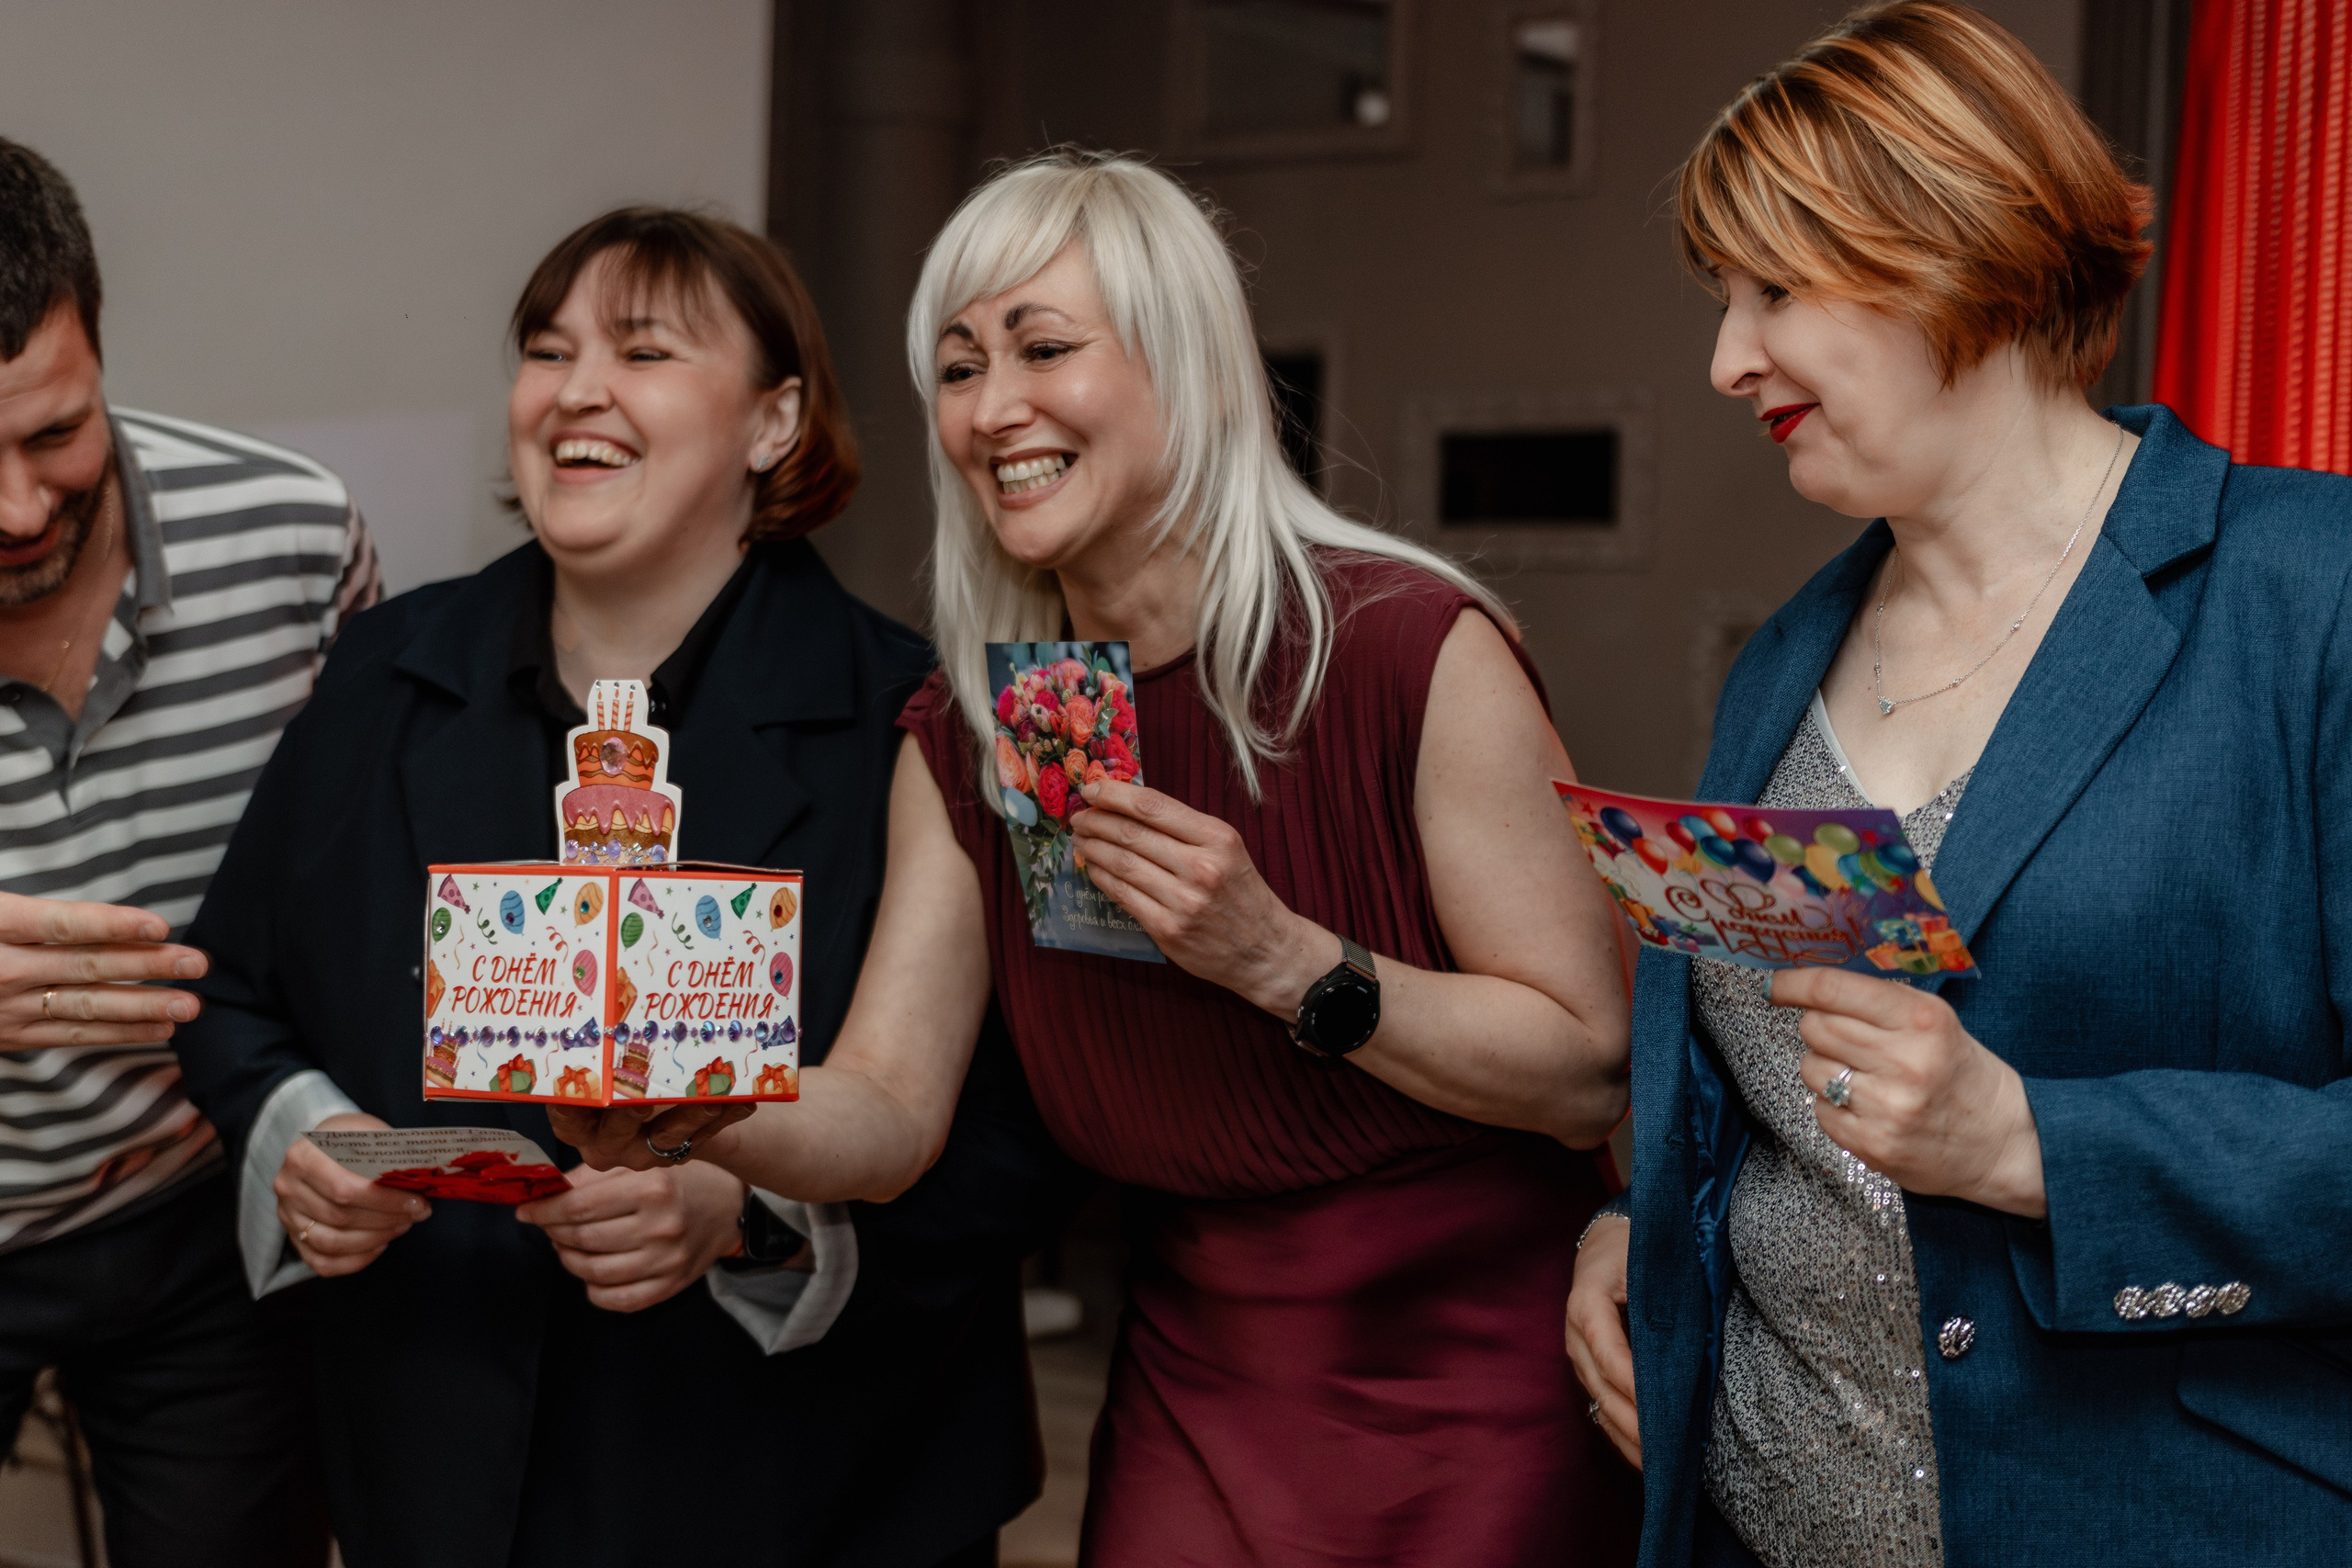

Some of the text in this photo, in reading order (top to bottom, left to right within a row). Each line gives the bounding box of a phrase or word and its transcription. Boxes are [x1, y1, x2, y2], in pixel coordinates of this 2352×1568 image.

[1061, 905, 1099, 931] Здоровья
[1107, 911, 1127, 931] всех
[472, 952, 557, 986] С ДНЁМ
[667, 956, 755, 988] С ДНЁМ
[451, 985, 578, 1019] РОЖДЕНИЯ
[644, 992, 775, 1021] РОЖДЕНИЯ
